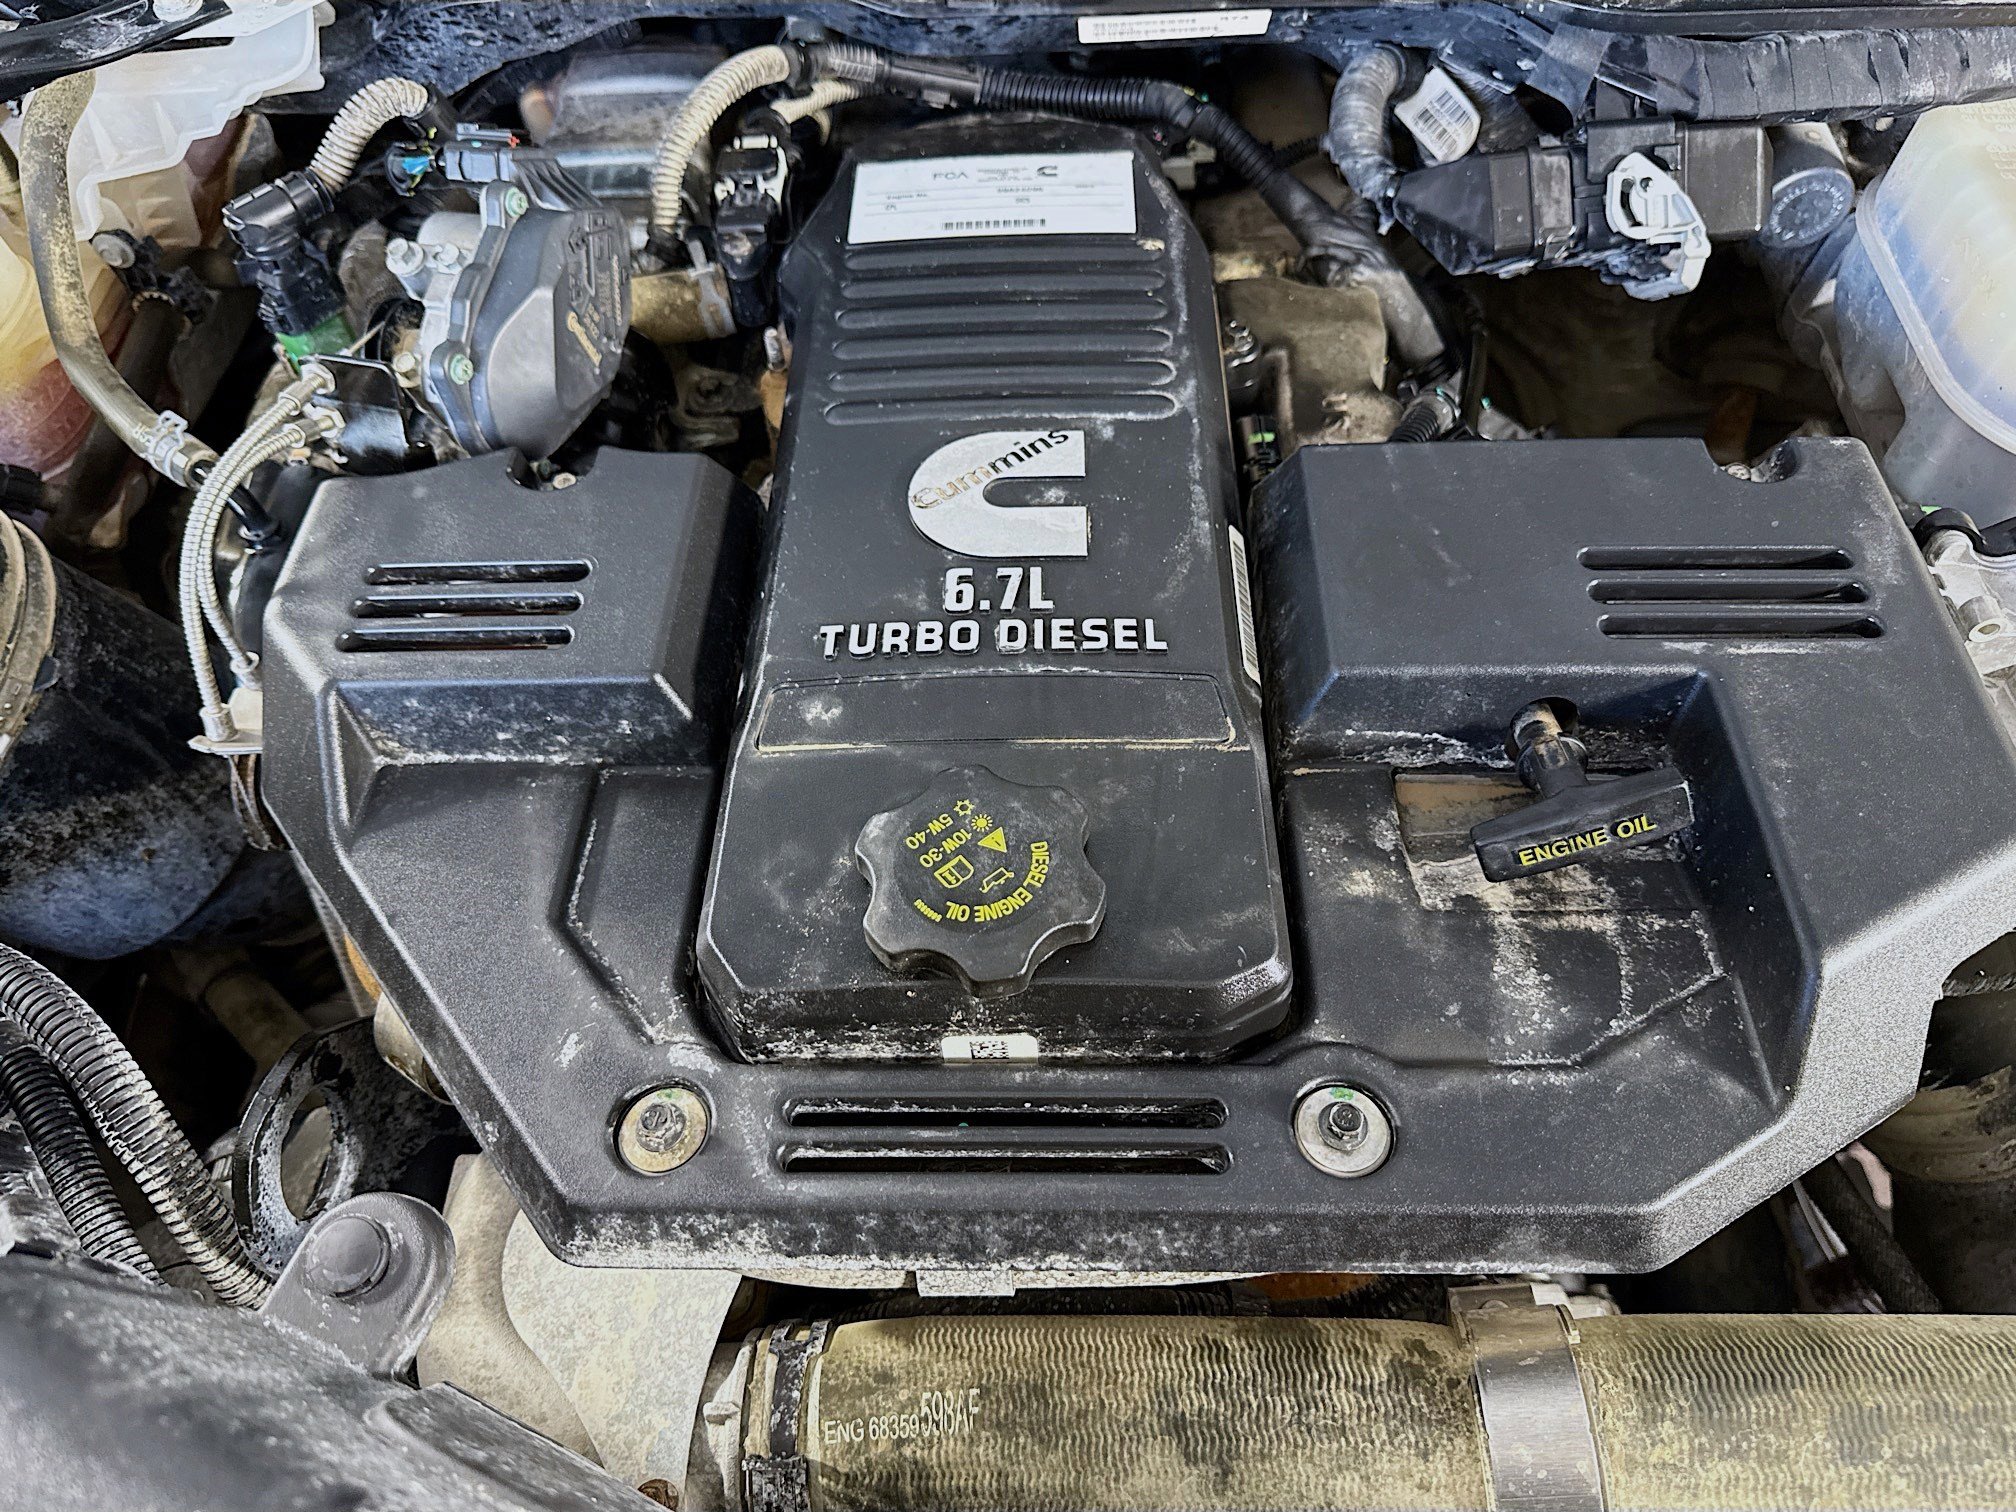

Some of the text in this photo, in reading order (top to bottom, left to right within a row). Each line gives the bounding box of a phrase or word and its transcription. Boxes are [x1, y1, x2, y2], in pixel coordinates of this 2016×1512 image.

[910, 429, 1070, 509] Cummins
[943, 566, 1054, 613] 6.7L
[820, 618, 1169, 658] TURBO DIESEL
[905, 813, 954, 850] 5W-40
[919, 829, 972, 868] 10W-30
[1518, 813, 1657, 866] ENGINE OIL
[1023, 841, 1050, 888] DIESEL
[945, 901, 971, 922] OIL
[974, 887, 1033, 923] ENGINE
[824, 1388, 981, 1445] ENG 68359598AF
